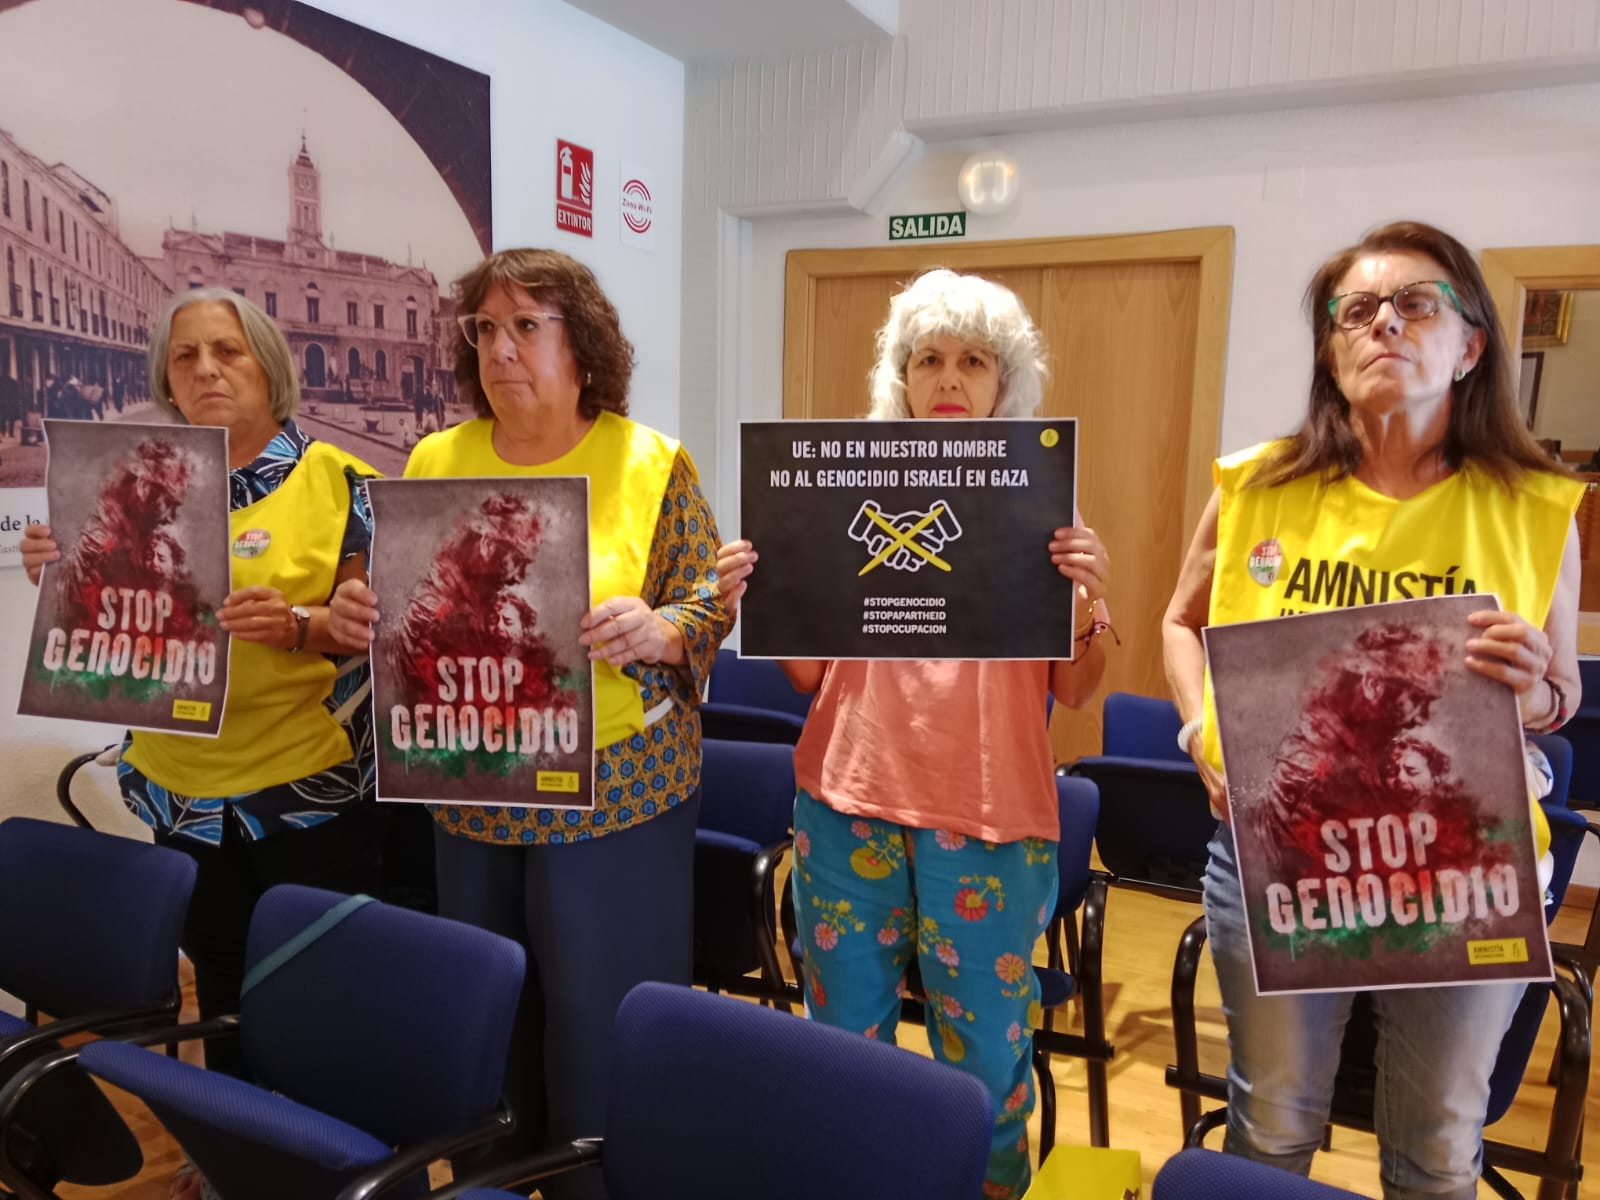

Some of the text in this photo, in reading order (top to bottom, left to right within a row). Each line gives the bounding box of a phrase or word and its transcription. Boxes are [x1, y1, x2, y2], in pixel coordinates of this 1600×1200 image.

[557, 208, 592, 232] EXTINTOR
[891, 214, 963, 238] SALIDA
[792, 439, 1007, 458] UE: NO EN NUESTRO NOMBRE
[770, 466, 1029, 487] NO AL GENOCIDIO ISRAELÍ EN GAZA
[0, 515, 21, 532] de
[97, 586, 173, 633] STOP
[863, 597, 946, 607] #STOPGENOCIDIO
[863, 611, 947, 620] #STOPAPARTHEID
[862, 624, 947, 634] #STOPOCUPACION
[43, 627, 216, 685] GENOCIDIO
[436, 656, 525, 703] STOP
[390, 703, 579, 755] GENOCIDIO
[1320, 811, 1438, 873] STOP
[1265, 863, 1520, 935] GENOCIDIO
